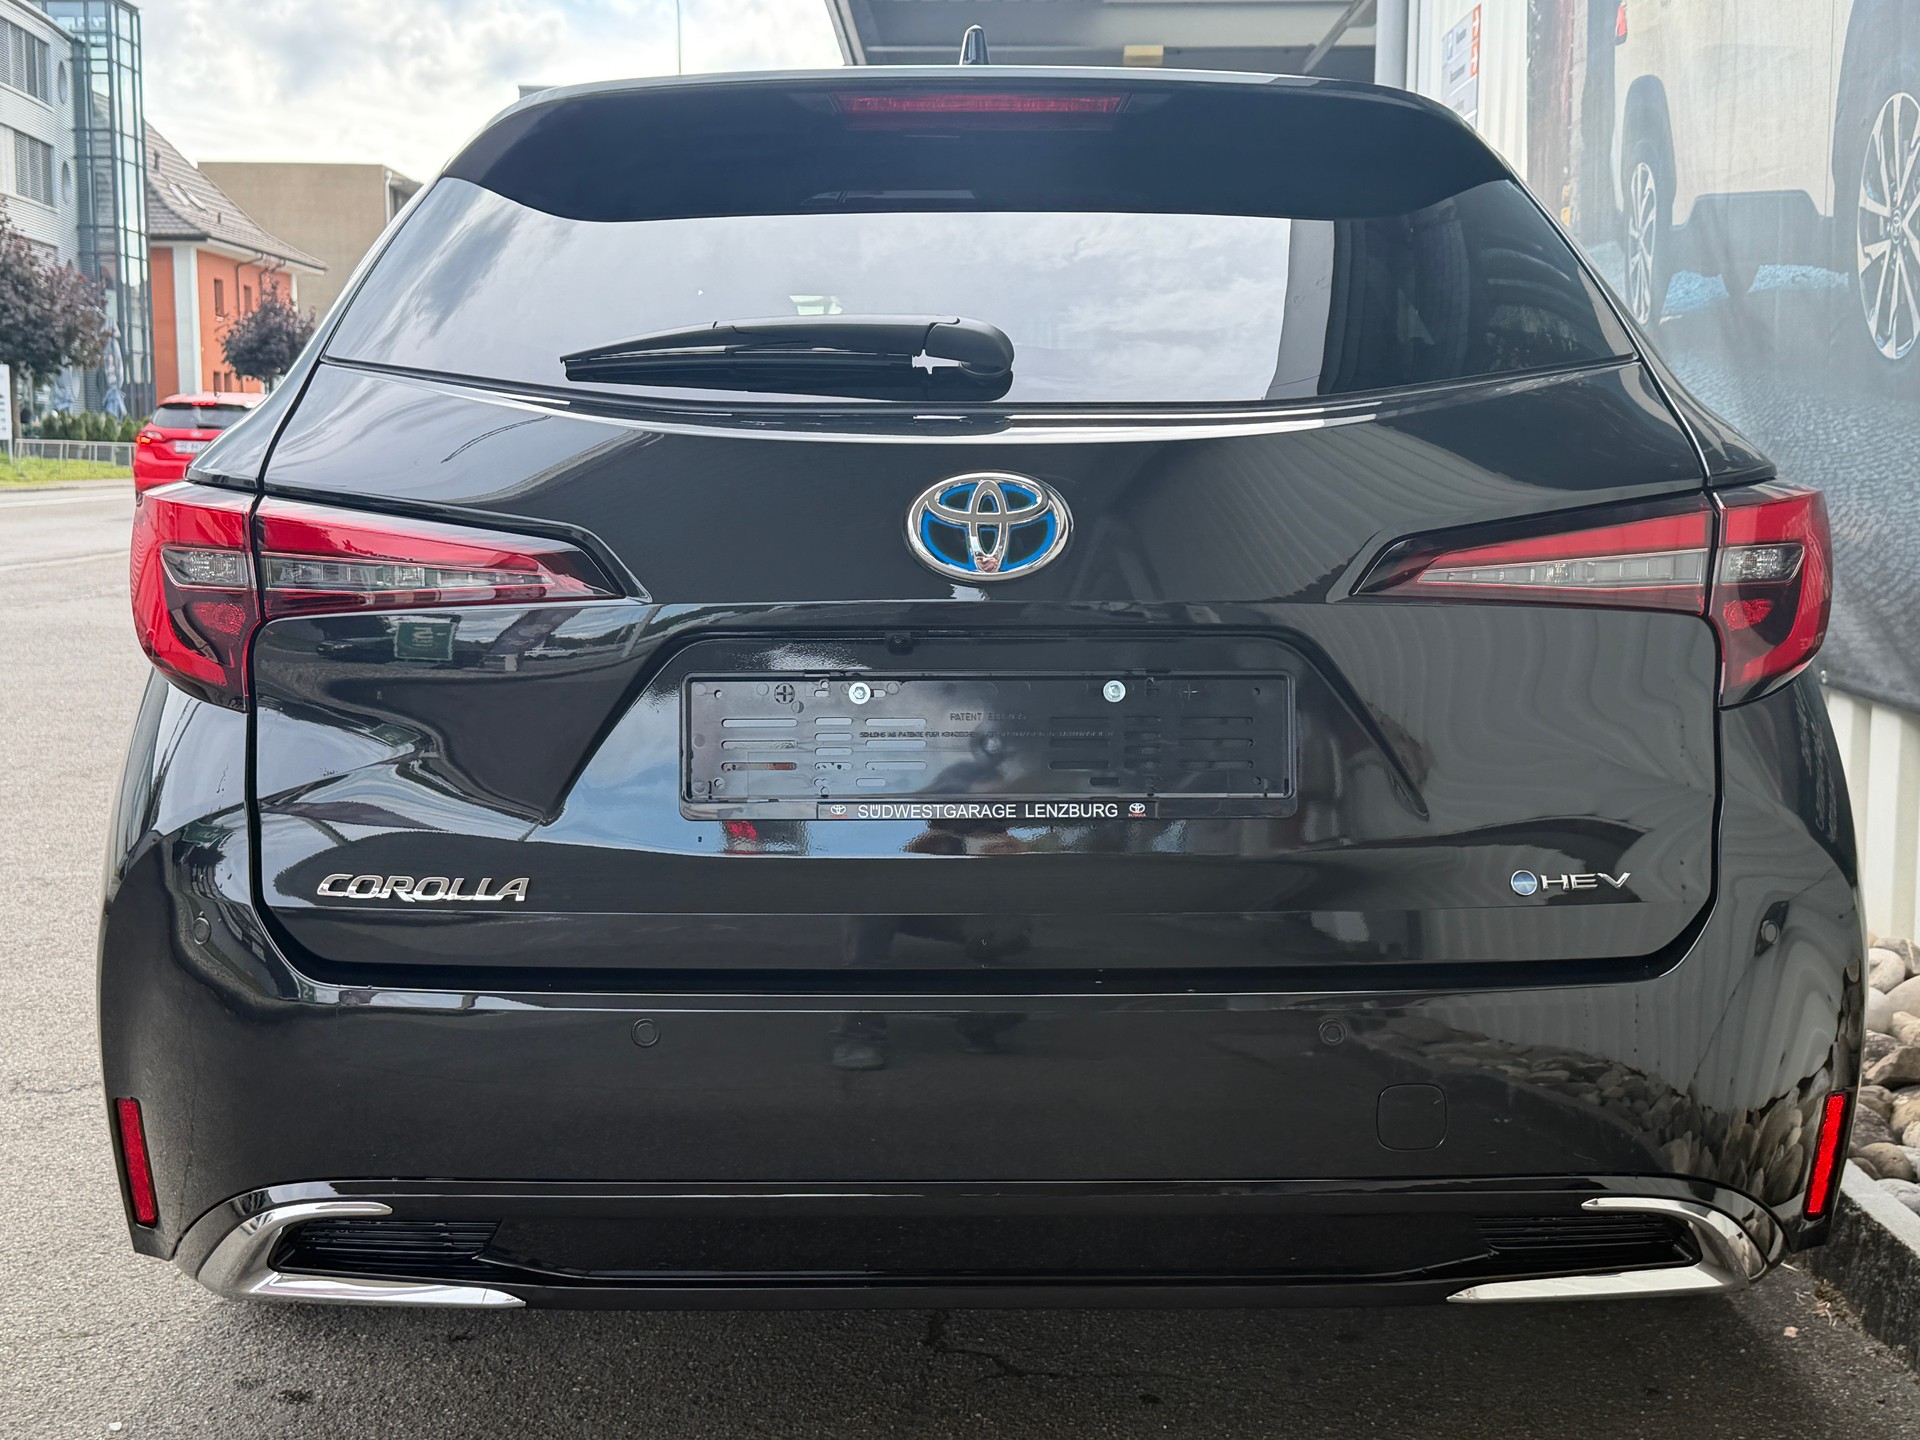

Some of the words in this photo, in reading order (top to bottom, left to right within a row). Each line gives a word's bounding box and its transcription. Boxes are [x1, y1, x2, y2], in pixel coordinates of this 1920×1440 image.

[949, 712, 982, 721] PATENT
[857, 804, 1017, 819] SÜDWESTGARAGE
[1025, 803, 1118, 818] LENZBURG
[316, 873, 530, 902] COROLLA
[1540, 872, 1631, 890] HEV
